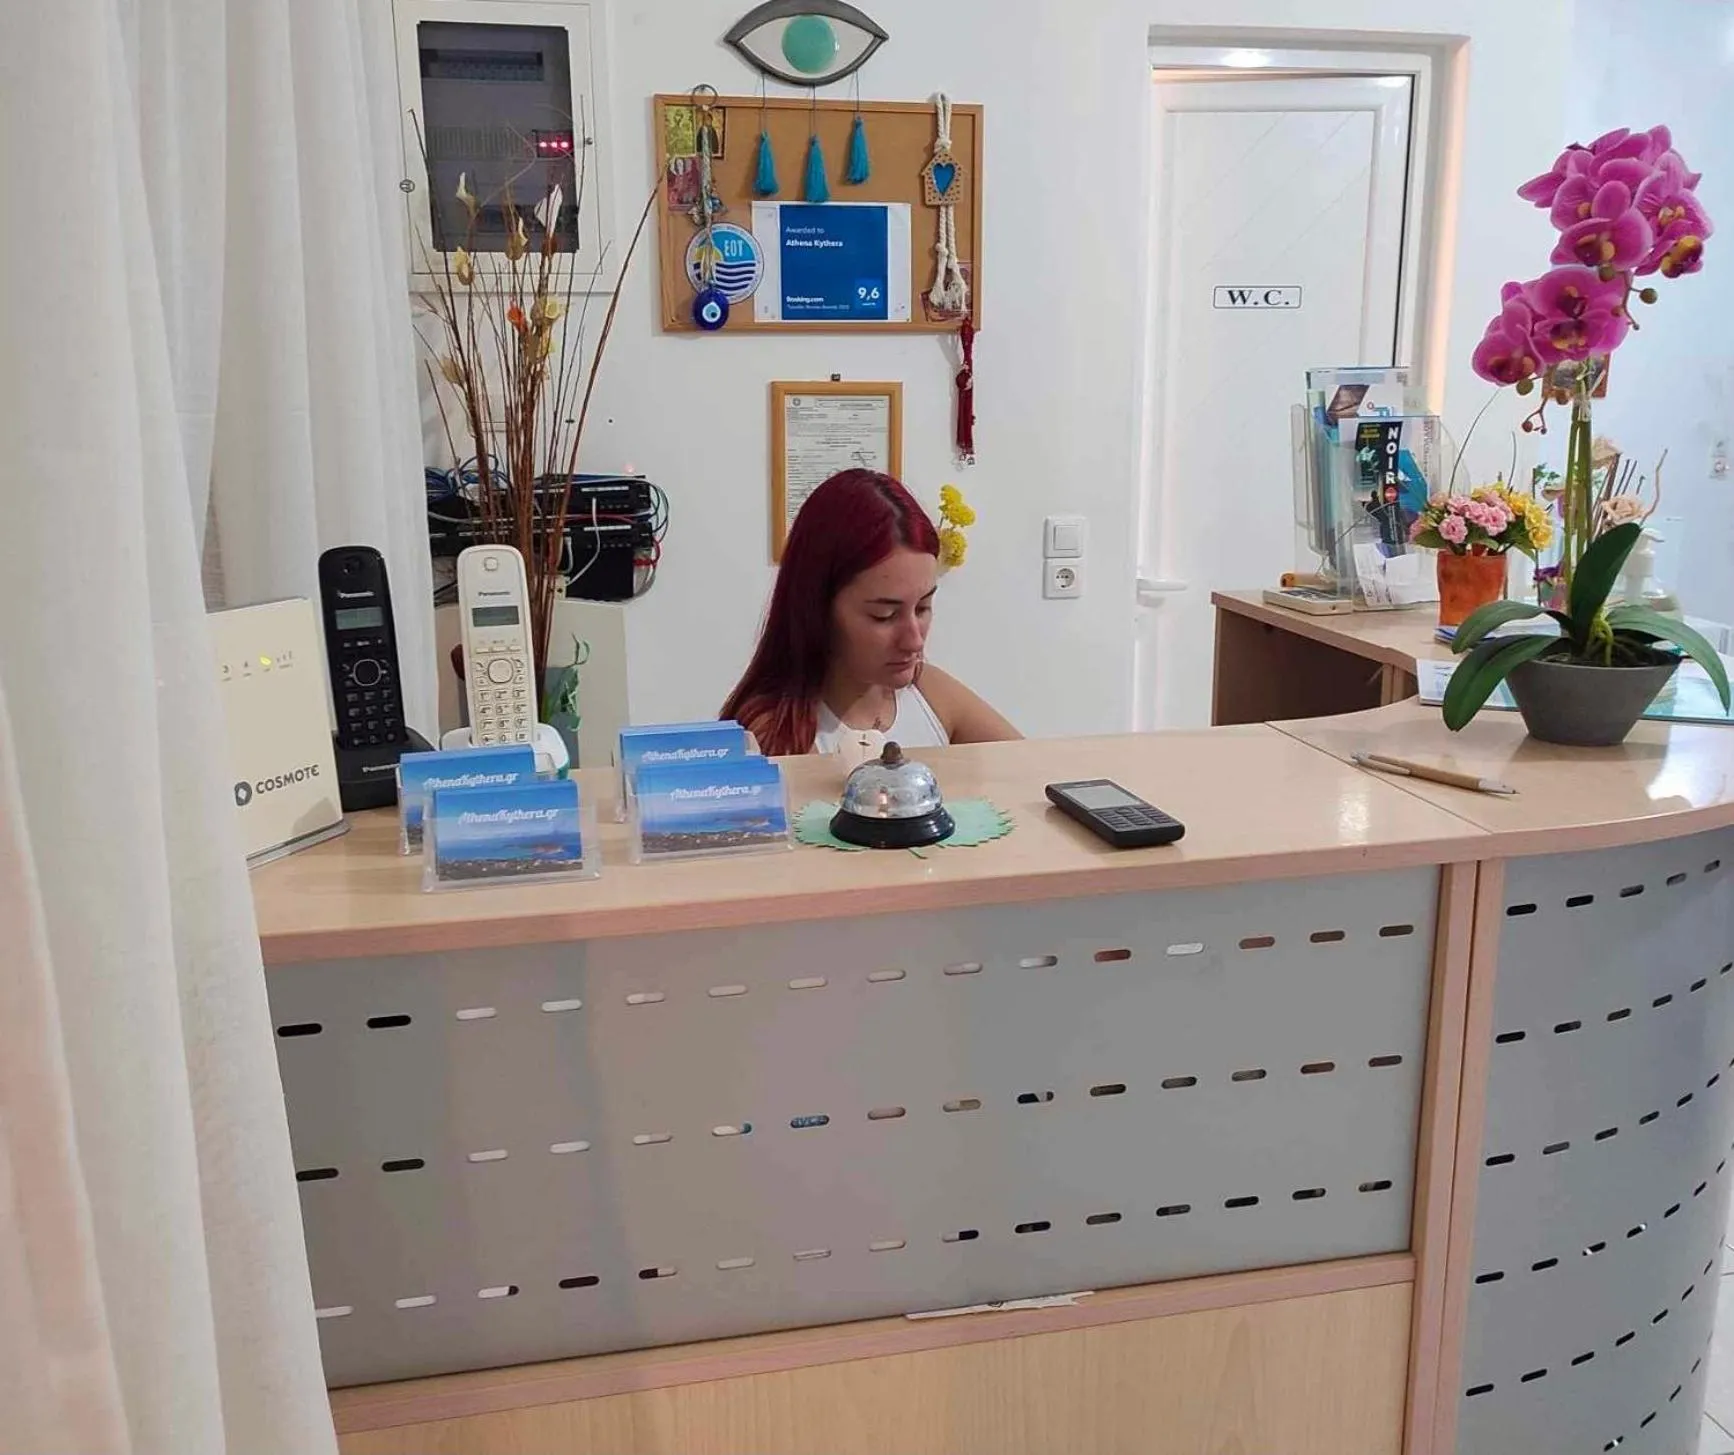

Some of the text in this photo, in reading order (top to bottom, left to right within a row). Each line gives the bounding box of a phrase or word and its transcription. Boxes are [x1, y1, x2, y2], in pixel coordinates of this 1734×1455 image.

[785, 226, 816, 234] Awarded
[785, 239, 844, 249] Athena Kythera
[858, 286, 880, 301] 9,6
[1226, 289, 1290, 306] W.C.
[1385, 426, 1399, 485] NOIR
[255, 764, 321, 795] COSMOTE
